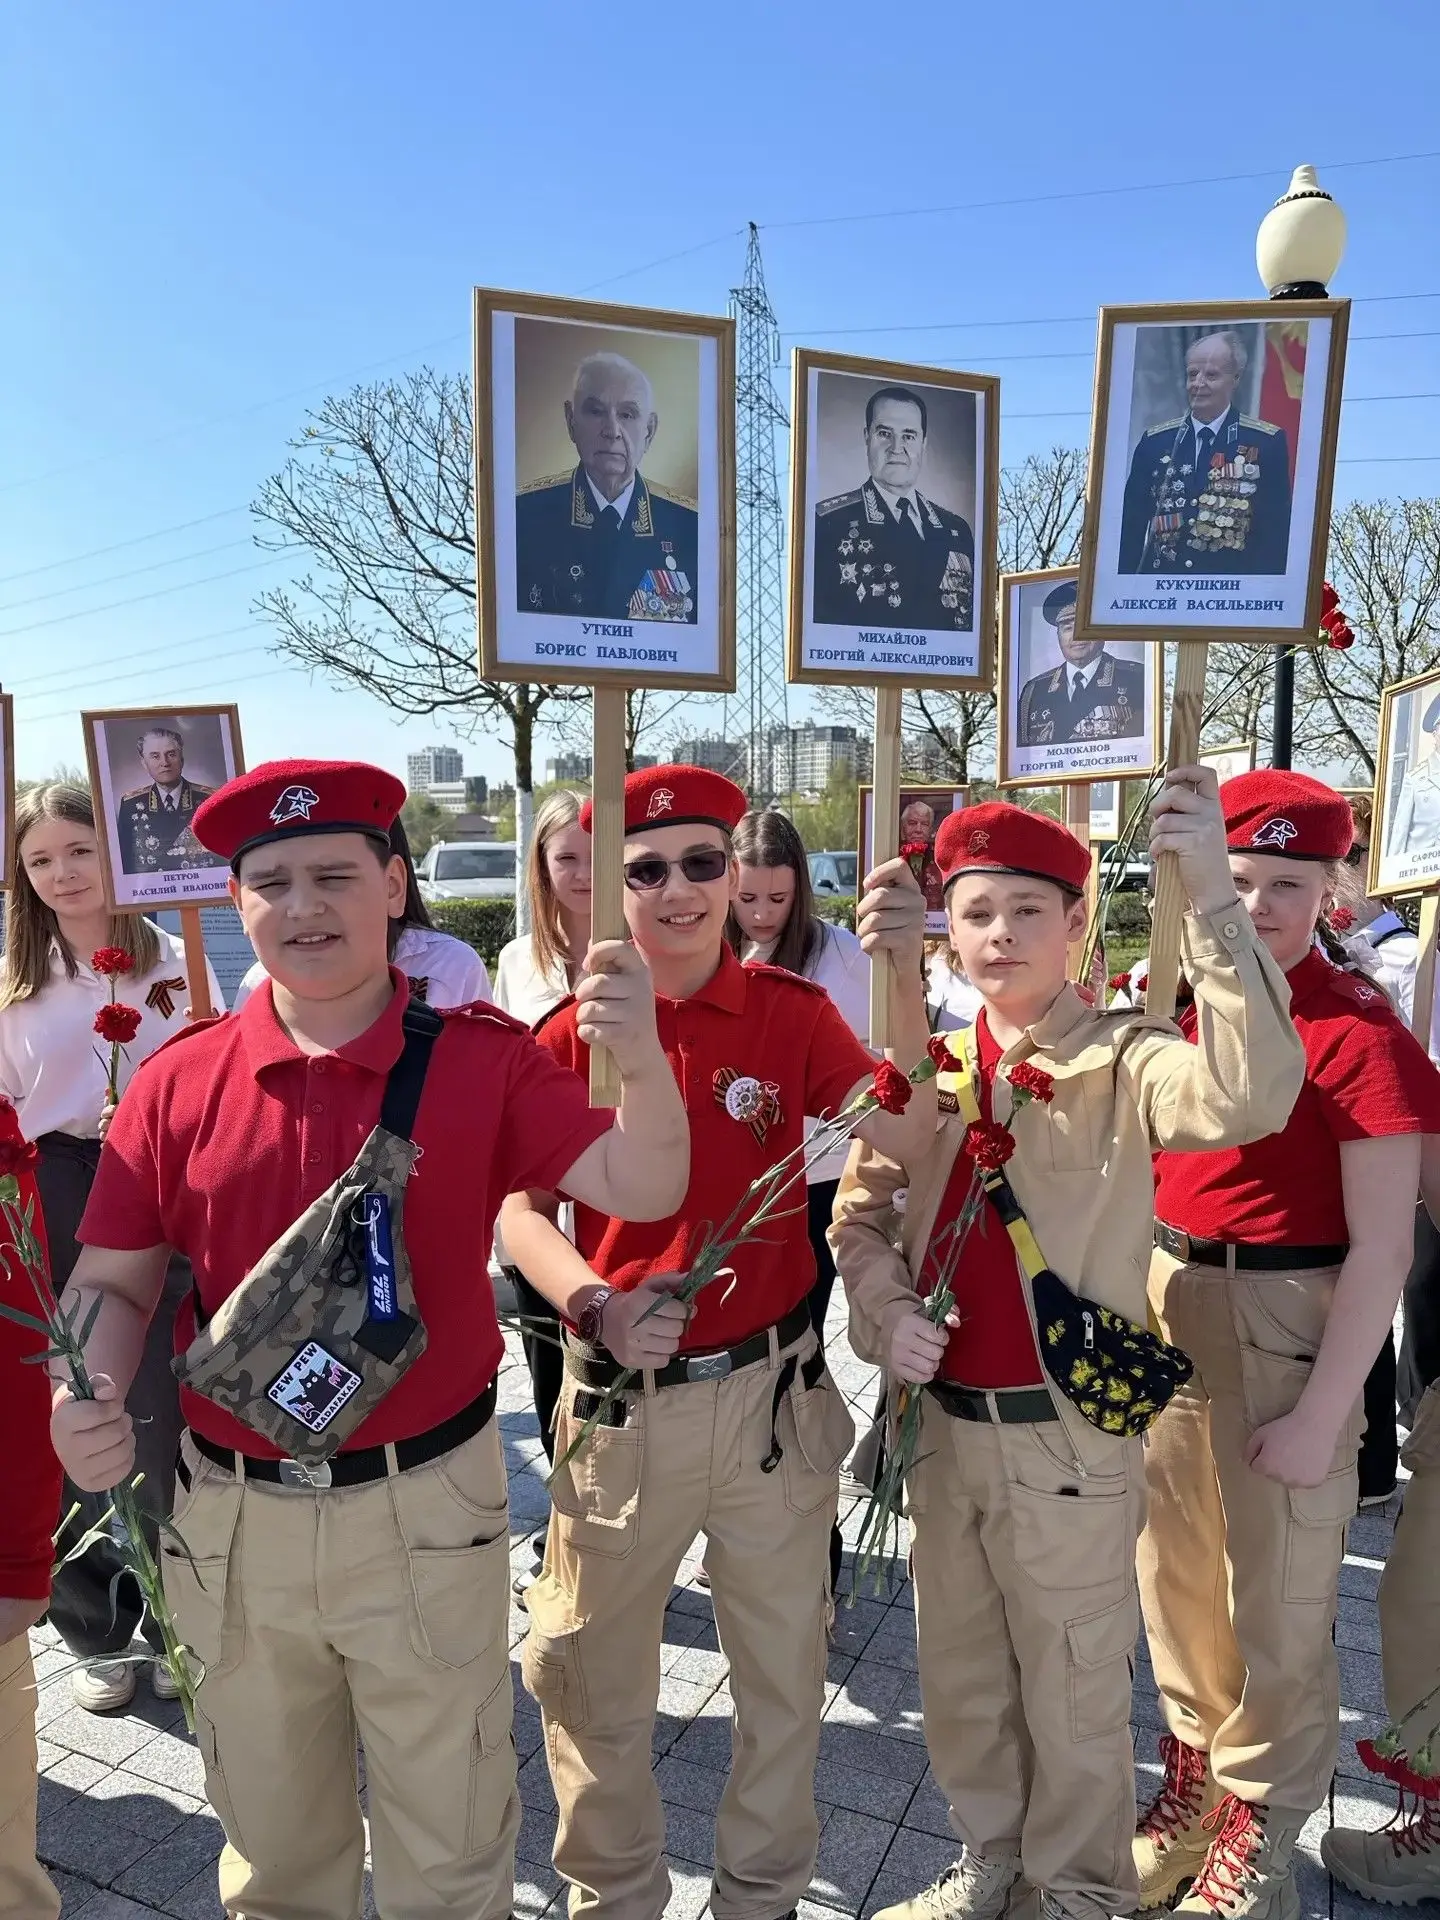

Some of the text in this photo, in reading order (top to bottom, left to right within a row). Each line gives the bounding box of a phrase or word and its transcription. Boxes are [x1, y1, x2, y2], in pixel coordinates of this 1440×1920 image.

[1155, 579, 1241, 591] КУКУШКИН
[1110, 597, 1284, 611] АЛЕКСЕЙ ВАСИЛЬЕВИЧ
[581, 622, 633, 638] УТКИН
[858, 632, 927, 646] МИХАЙЛОВ
[535, 642, 678, 662] БОРИС ПАВЛОВИЧ
[809, 648, 974, 667] ГЕОРГИЙ АЛЕКСАНДРОВИЧ
[1046, 744, 1110, 756] МОЛОКАНОВ
[1020, 754, 1138, 772] ГЕОРГИЙ ФЕДОСЕЕВИЧ
[163, 872, 200, 882] ПЕТРОВ
[1399, 863, 1440, 879] ПЕТР ПАВ
[132, 885, 177, 897] ВАСИЛИЙ
[372, 1275, 386, 1313] 767
[270, 1343, 318, 1400] PEW PEW
